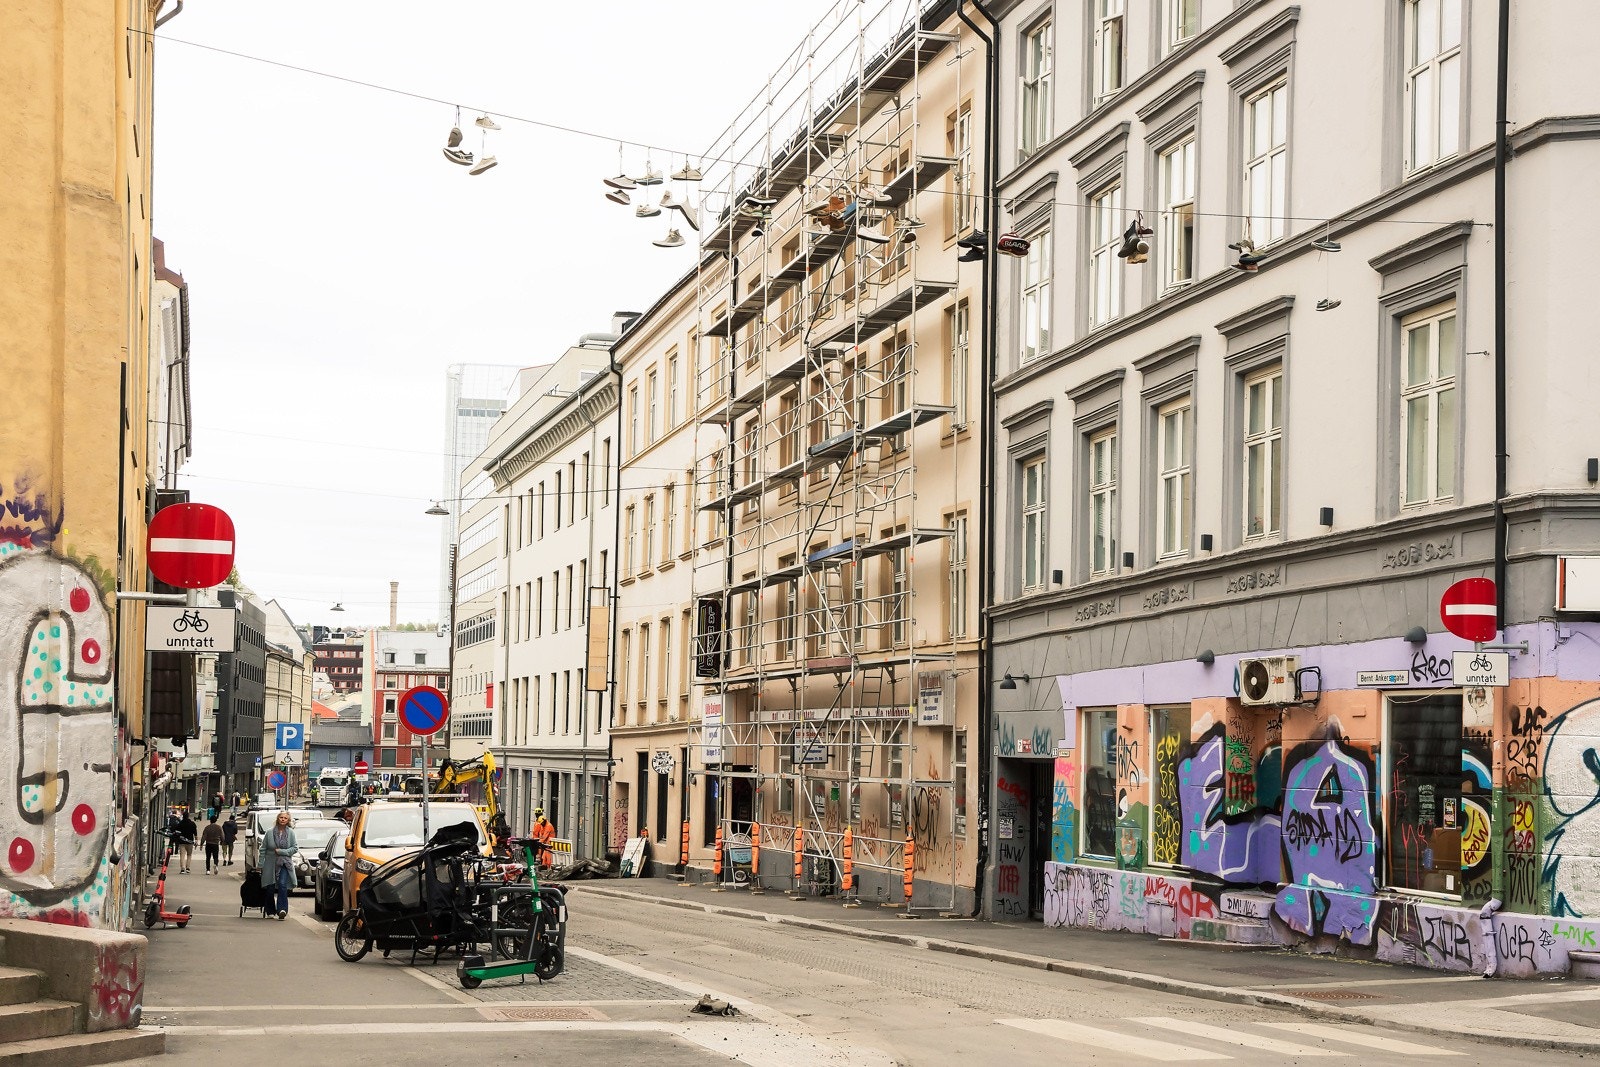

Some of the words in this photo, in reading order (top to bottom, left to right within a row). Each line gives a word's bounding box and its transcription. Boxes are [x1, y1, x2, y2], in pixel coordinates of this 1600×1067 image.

[166, 636, 215, 648] unntatt
[1360, 674, 1373, 682] Bernt
[1466, 674, 1497, 683] unntatt
[282, 726, 298, 747] P
